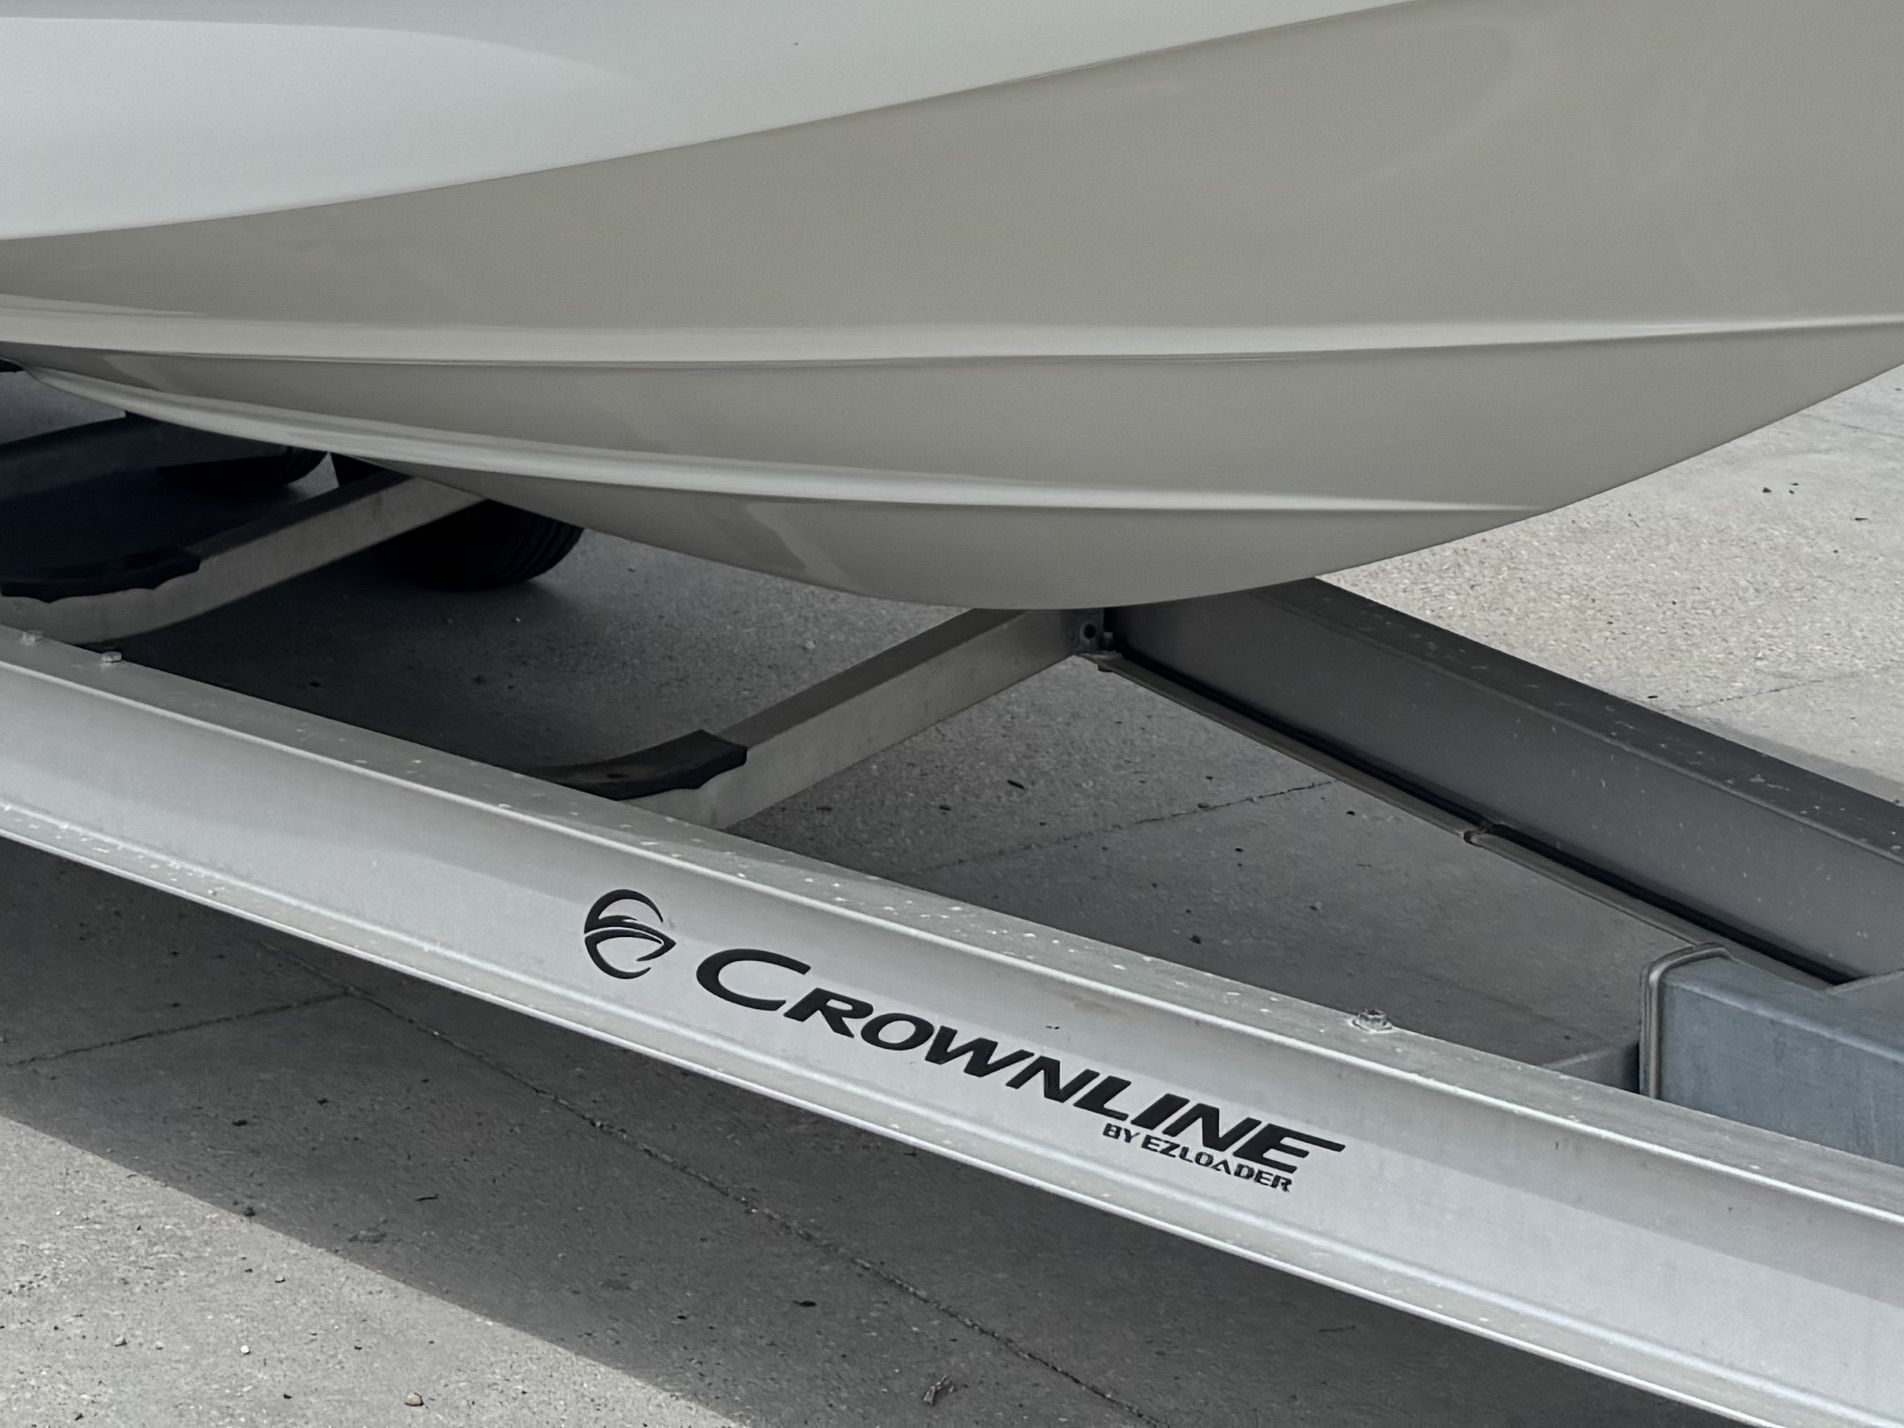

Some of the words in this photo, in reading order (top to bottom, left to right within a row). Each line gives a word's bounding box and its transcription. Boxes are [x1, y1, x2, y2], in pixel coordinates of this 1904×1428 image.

[696, 948, 1346, 1175] CROWNLINE
[1102, 1122, 1140, 1144] BY
[1141, 1134, 1293, 1193] EZLOADER
